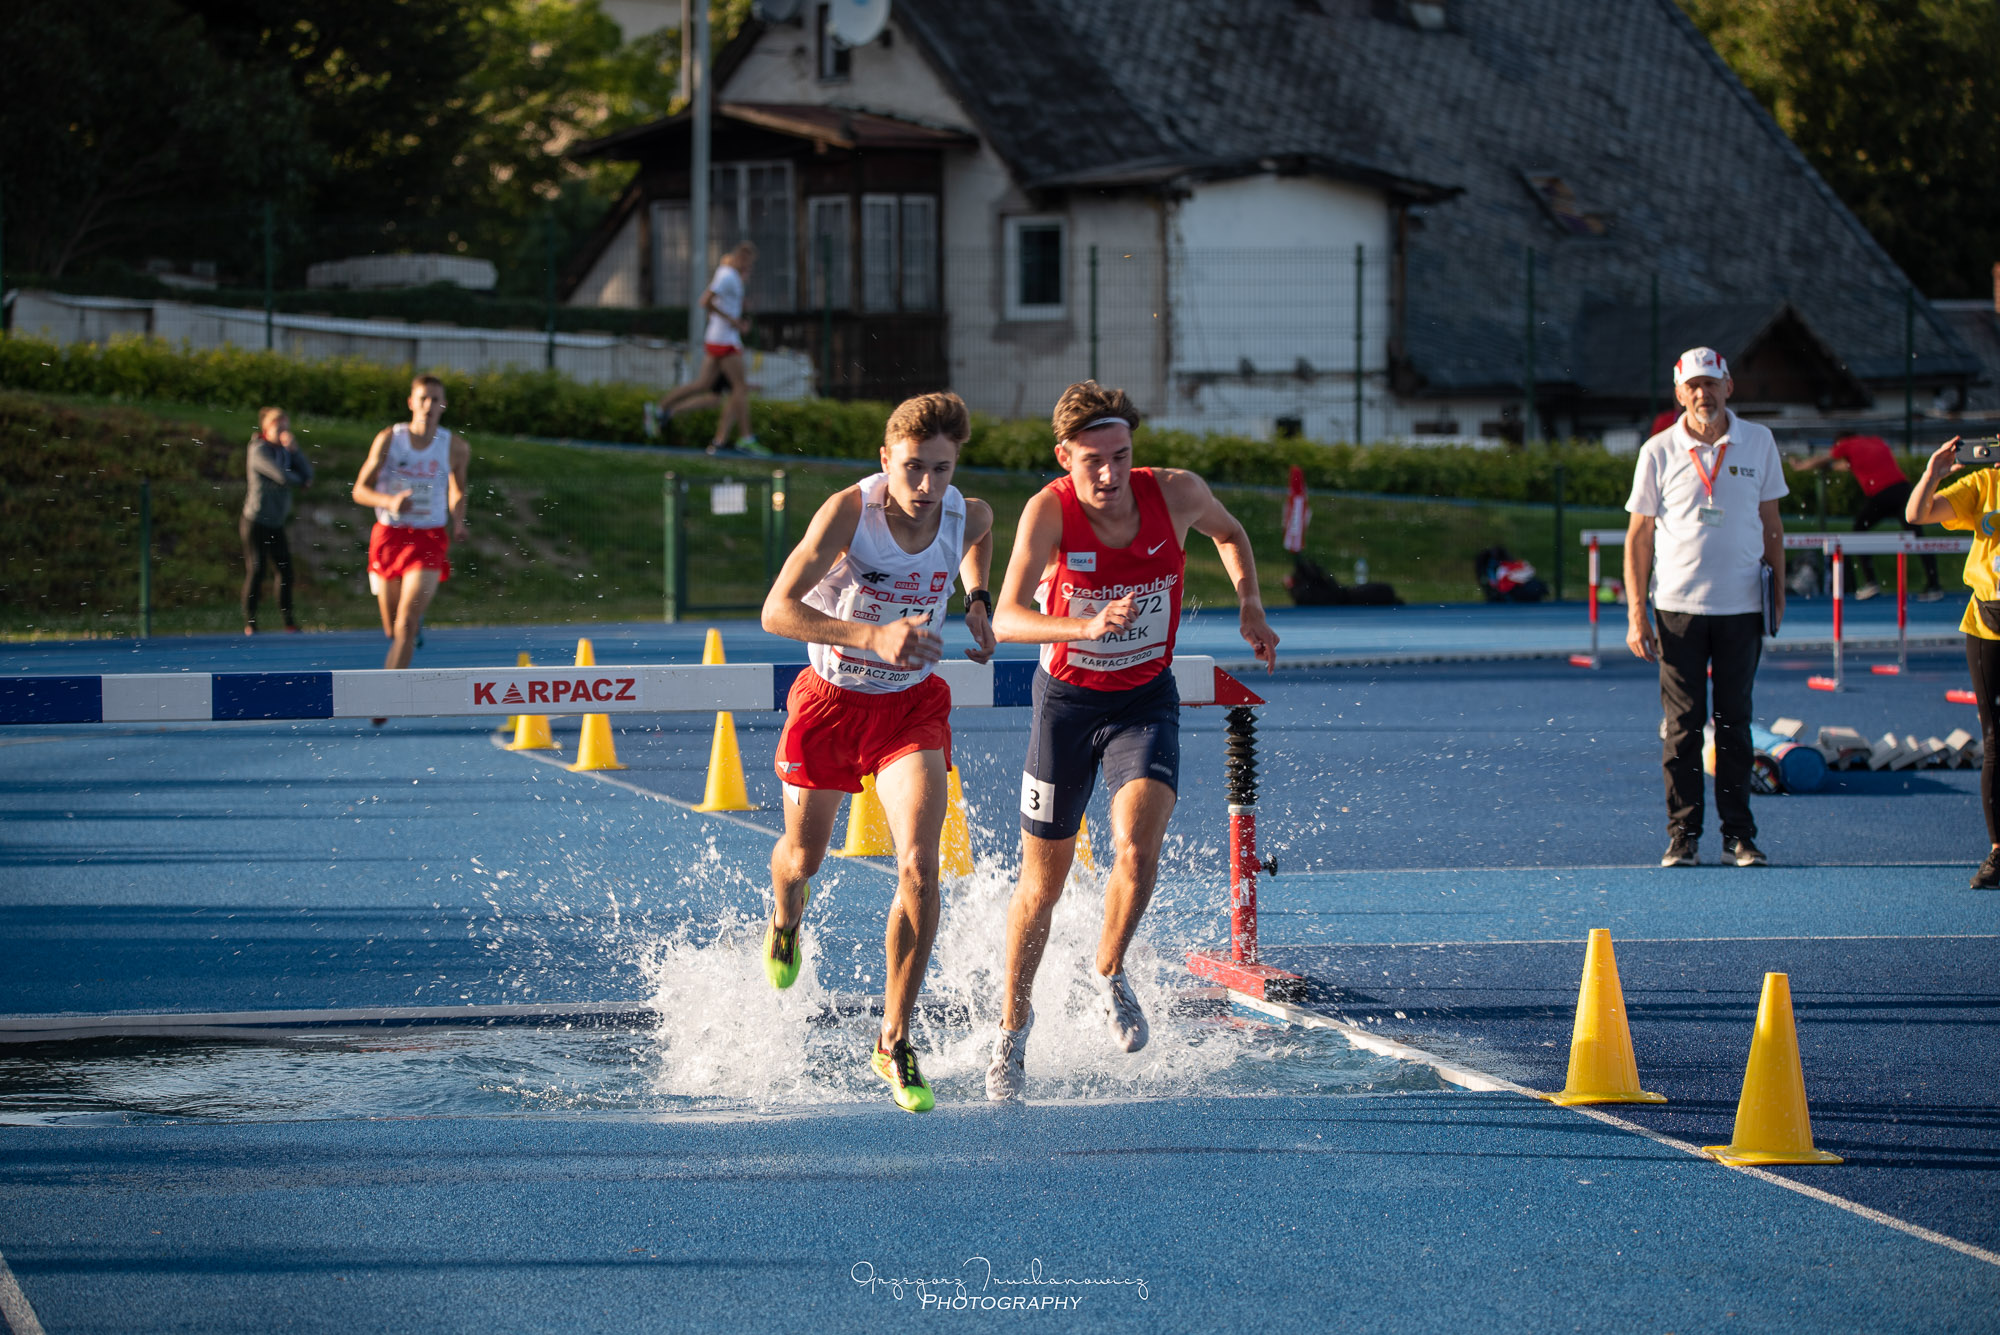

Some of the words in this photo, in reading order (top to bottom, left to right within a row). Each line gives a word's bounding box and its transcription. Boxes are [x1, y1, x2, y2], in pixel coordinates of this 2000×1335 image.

[862, 571, 890, 584] 4F
[895, 582, 919, 590] ORLEN
[859, 586, 939, 606] POLSKA
[1136, 595, 1163, 616] 72
[853, 611, 880, 621] ORLEN
[1081, 656, 1128, 668] KARPACZ
[1131, 650, 1152, 663] 2020
[838, 662, 887, 679] KARPACZ
[888, 672, 910, 682] 2020
[473, 678, 636, 705] KARPACZ
[1029, 788, 1041, 810] 3
